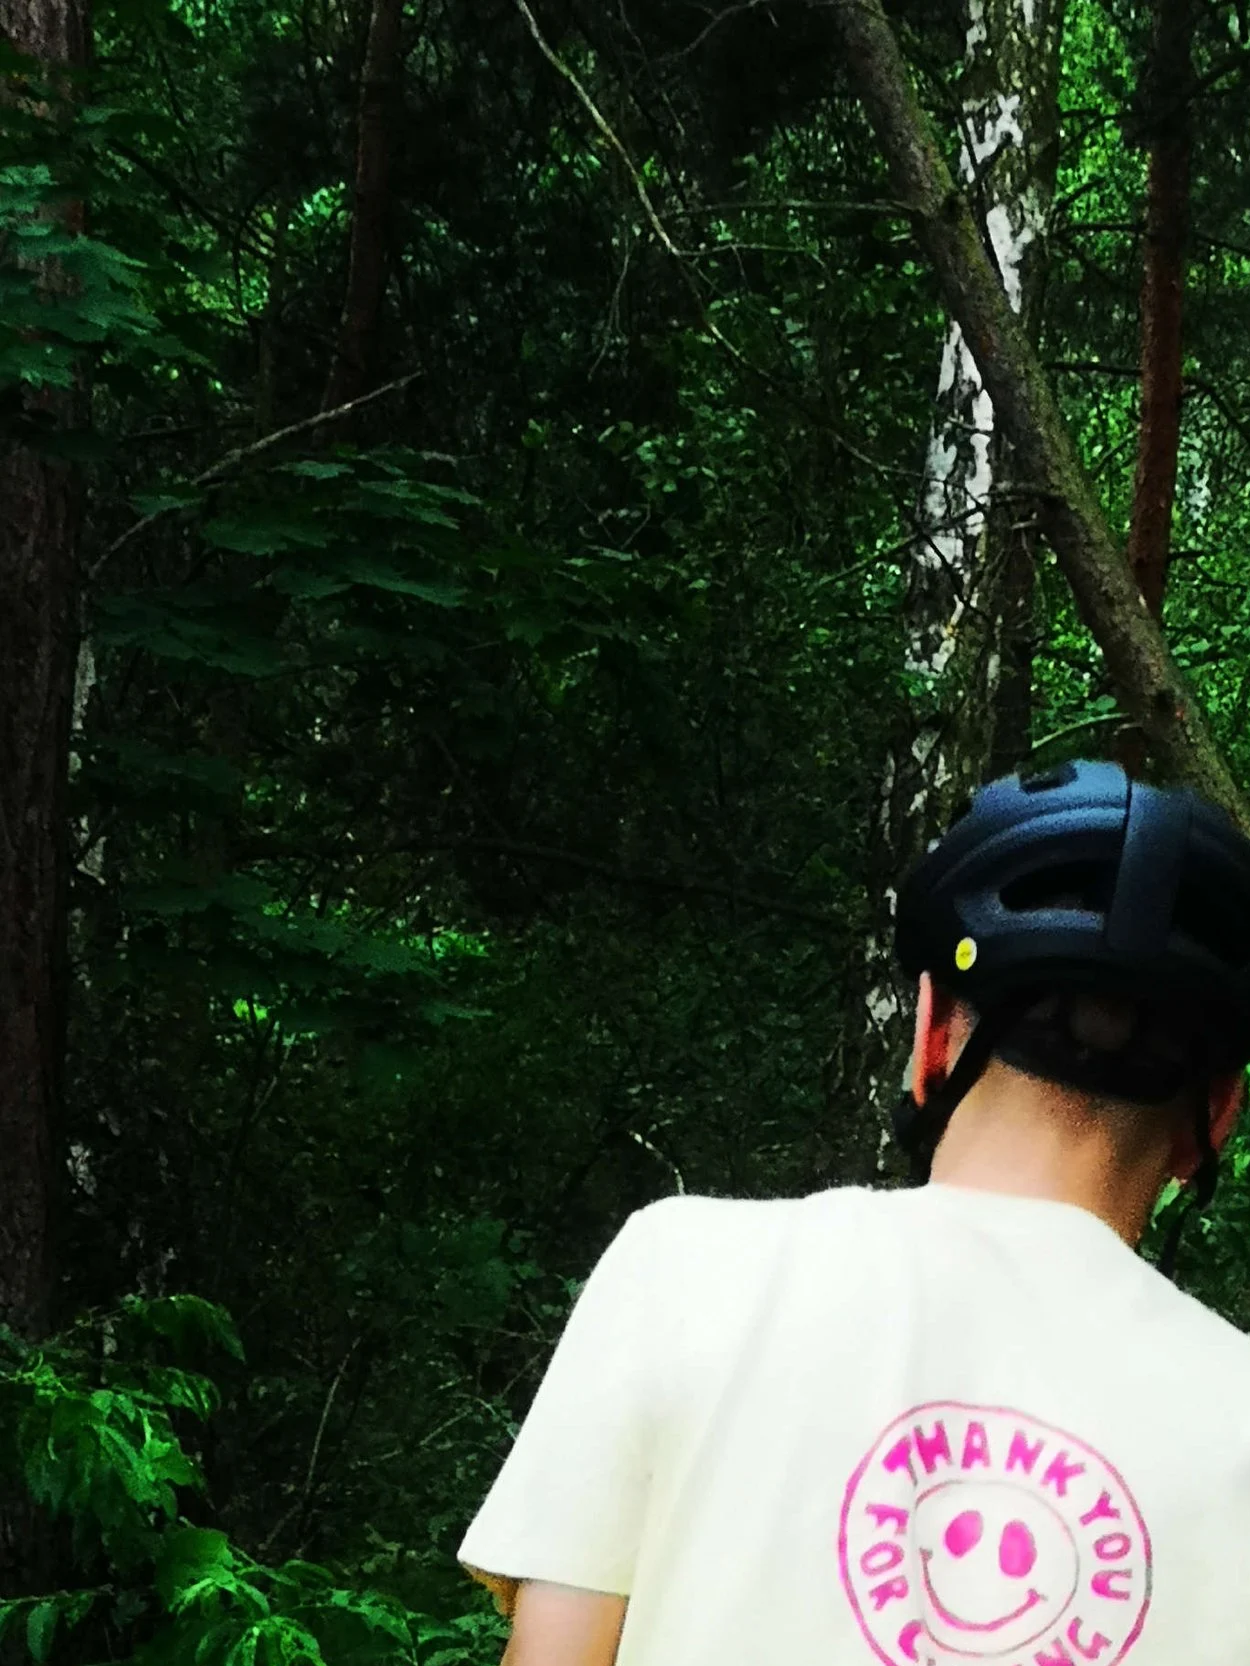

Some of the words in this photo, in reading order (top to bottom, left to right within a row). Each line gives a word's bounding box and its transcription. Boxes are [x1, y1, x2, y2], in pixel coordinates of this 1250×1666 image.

[883, 1420, 1086, 1496] THANK
[860, 1504, 909, 1611] FOR
[1080, 1489, 1132, 1601] YOU
